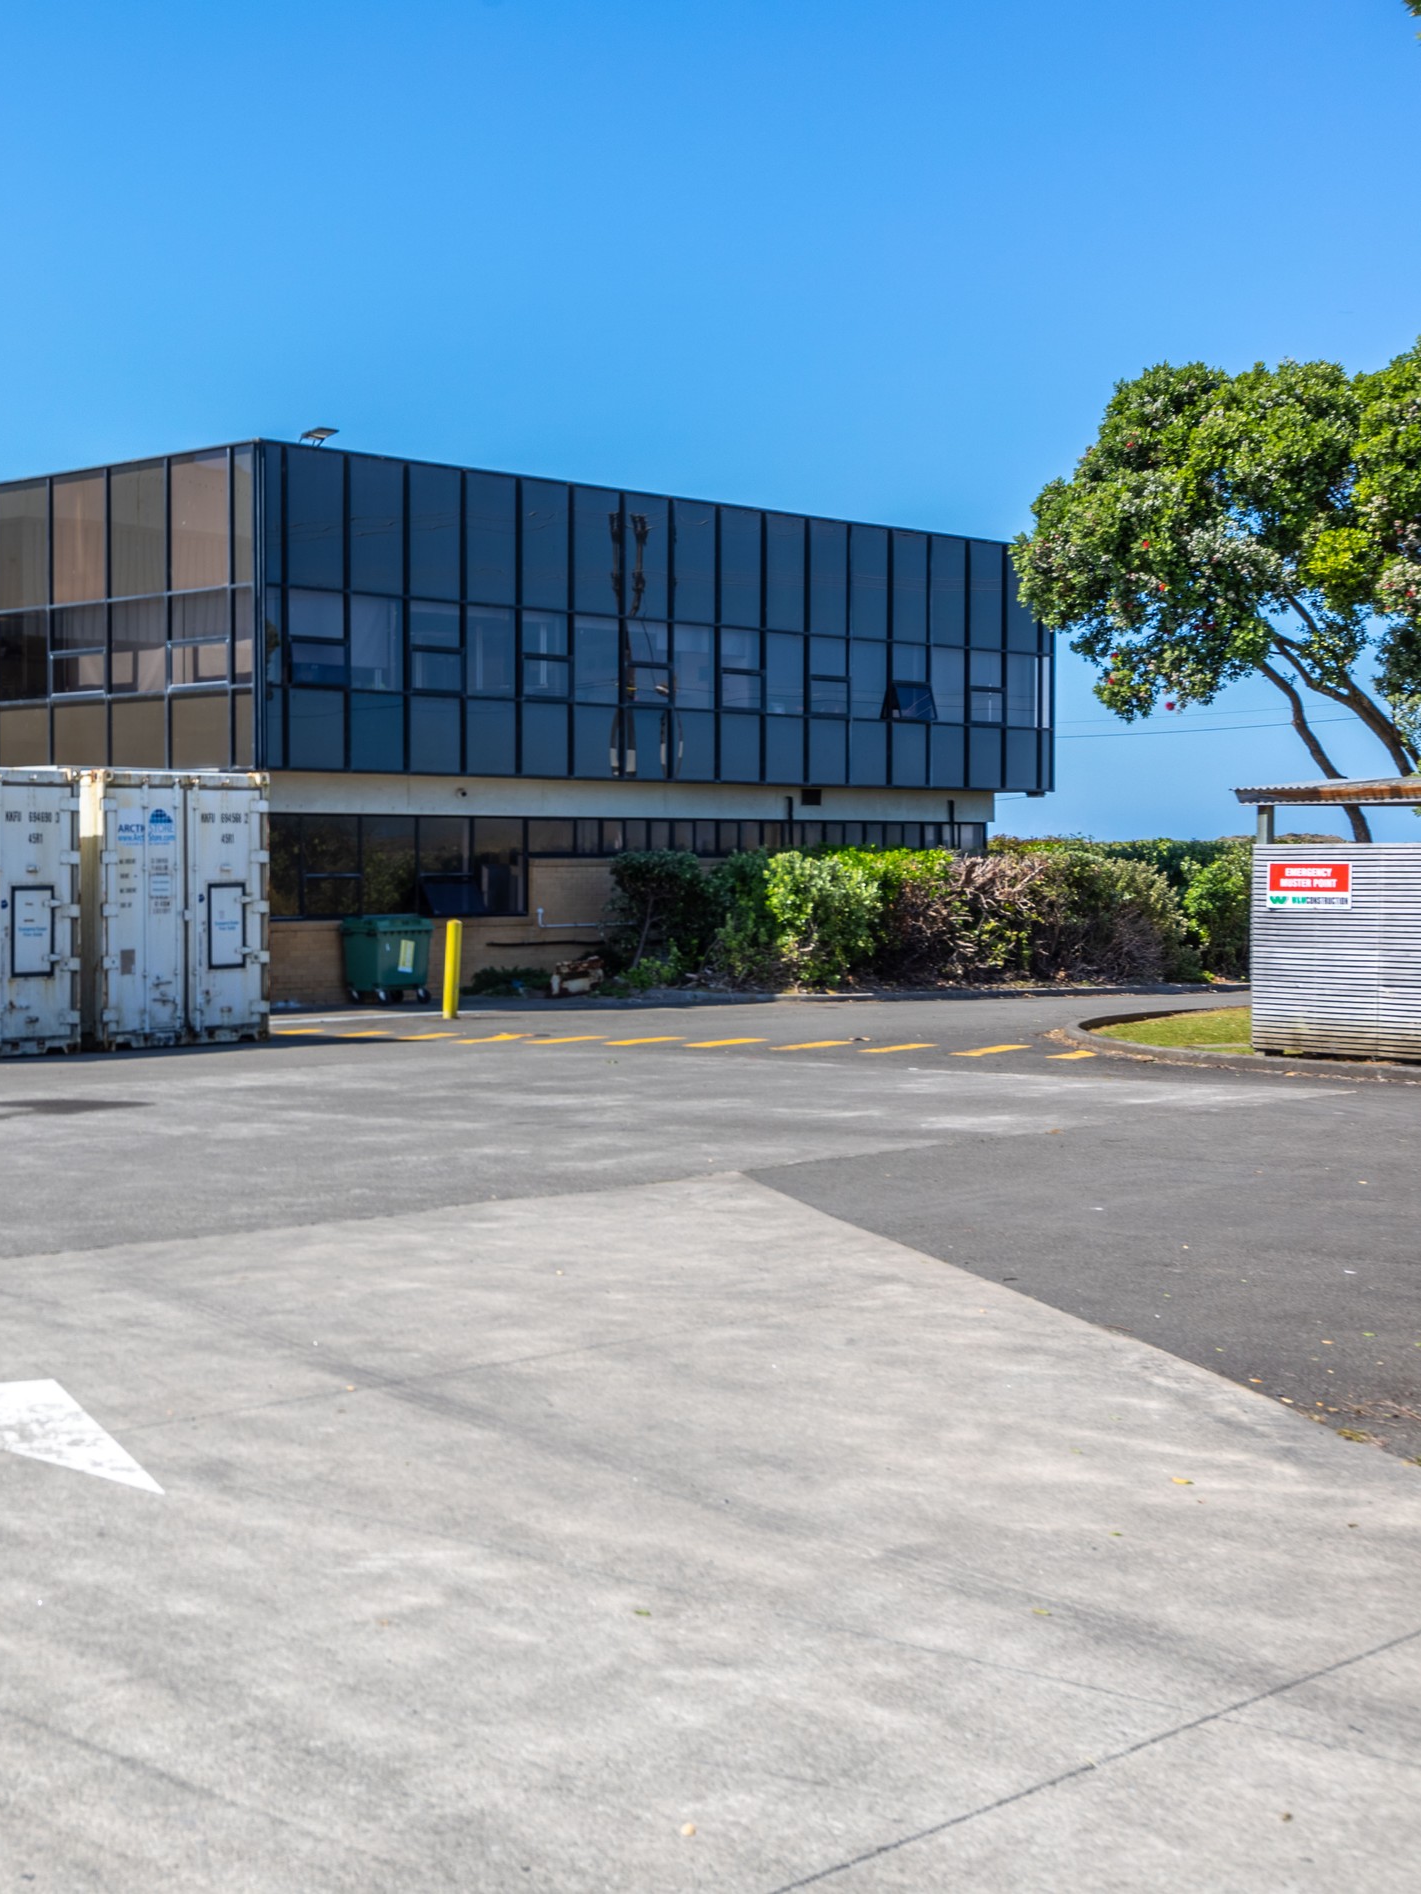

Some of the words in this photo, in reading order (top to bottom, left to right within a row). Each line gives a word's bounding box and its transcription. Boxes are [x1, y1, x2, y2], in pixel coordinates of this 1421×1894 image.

[148, 824, 174, 834] STORE
[1285, 868, 1333, 877] EMERGENCY
[1280, 878, 1312, 888] MUSTER
[1313, 878, 1337, 888] POINT
